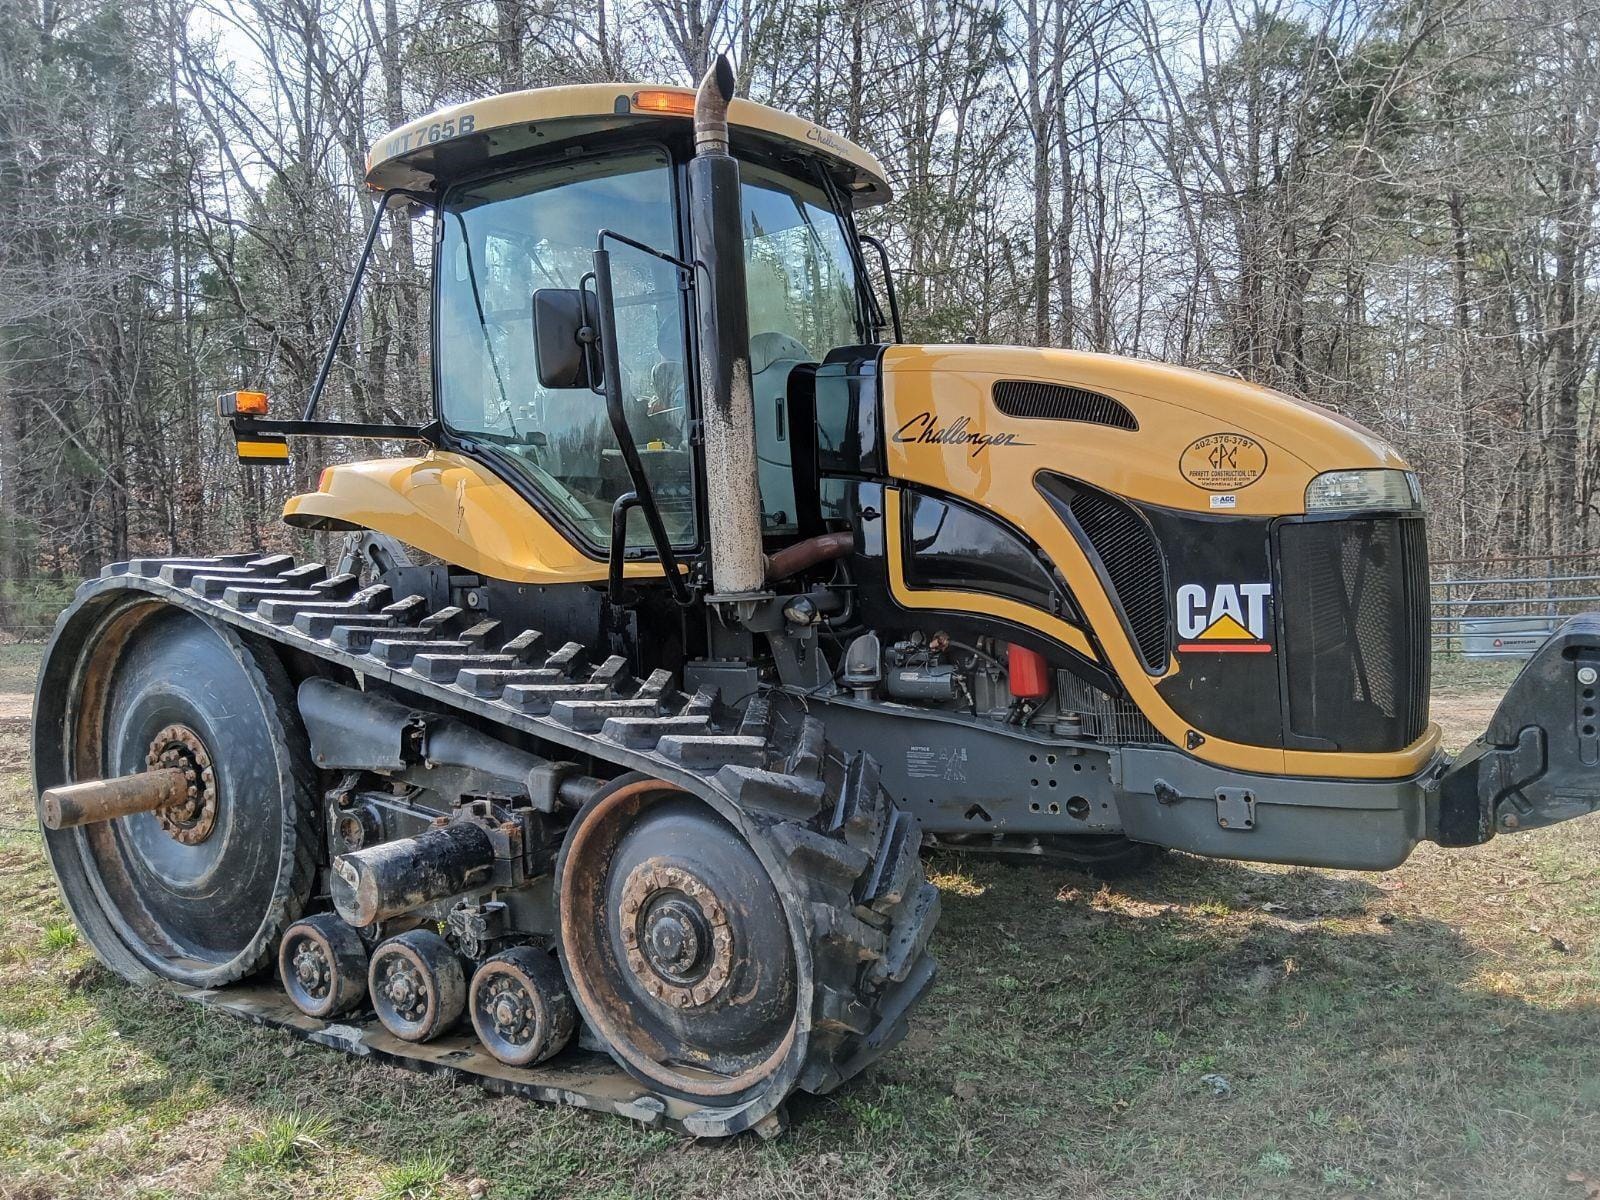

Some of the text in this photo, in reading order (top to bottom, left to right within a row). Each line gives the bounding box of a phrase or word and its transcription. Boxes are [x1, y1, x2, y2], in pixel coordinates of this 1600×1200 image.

[385, 132, 412, 158] MT
[892, 412, 1037, 457] Challenger
[1194, 435, 1254, 451] 402-376-3797
[1176, 583, 1271, 640] CAT
